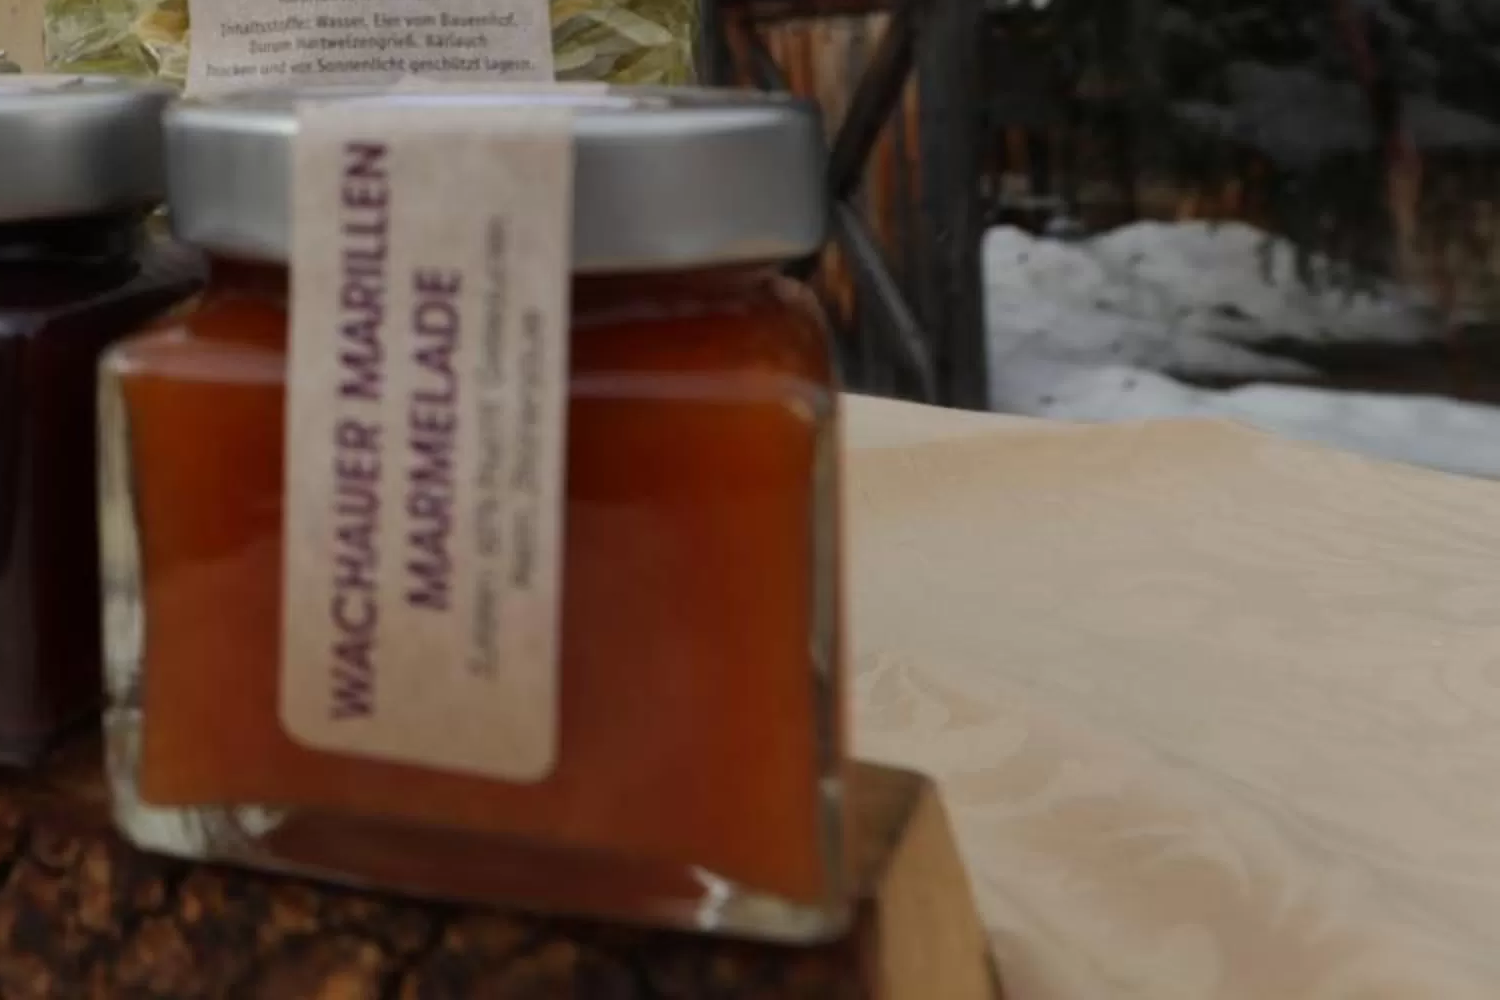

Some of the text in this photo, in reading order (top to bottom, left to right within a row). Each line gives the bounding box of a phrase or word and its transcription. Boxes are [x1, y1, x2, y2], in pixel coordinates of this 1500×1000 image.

[330, 141, 390, 722] WACHAUER MARILLEN
[406, 267, 462, 612] MARMELADE
